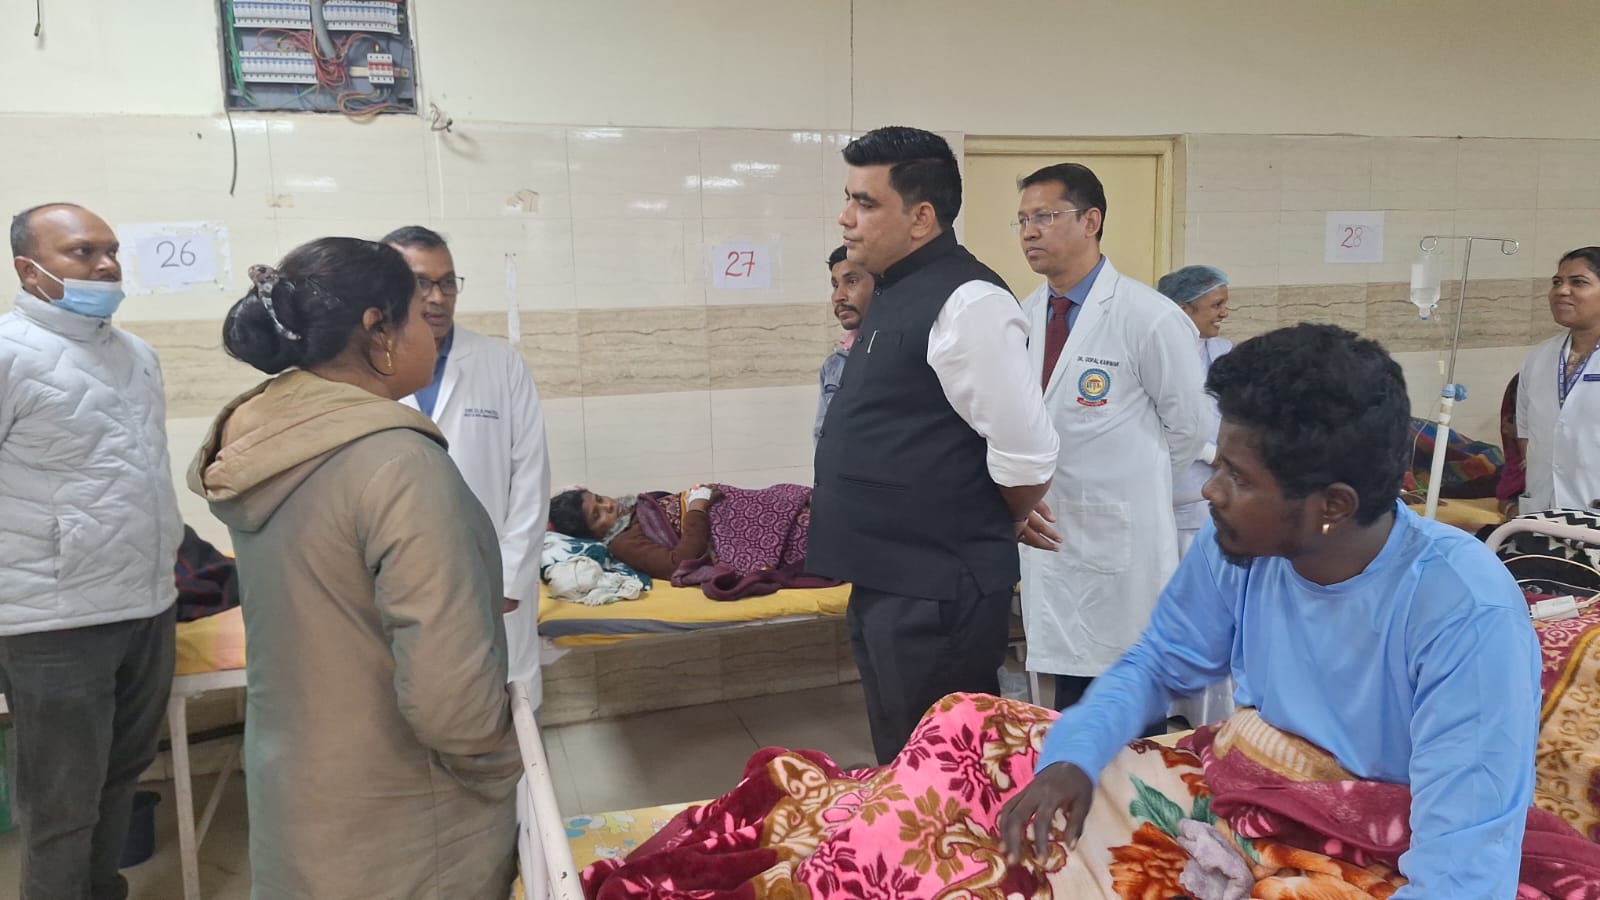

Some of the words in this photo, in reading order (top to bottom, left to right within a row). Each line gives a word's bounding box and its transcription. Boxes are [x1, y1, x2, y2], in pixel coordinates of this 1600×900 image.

[1340, 226, 1363, 249] 28
[156, 240, 197, 268] 26
[725, 250, 756, 277] 27
